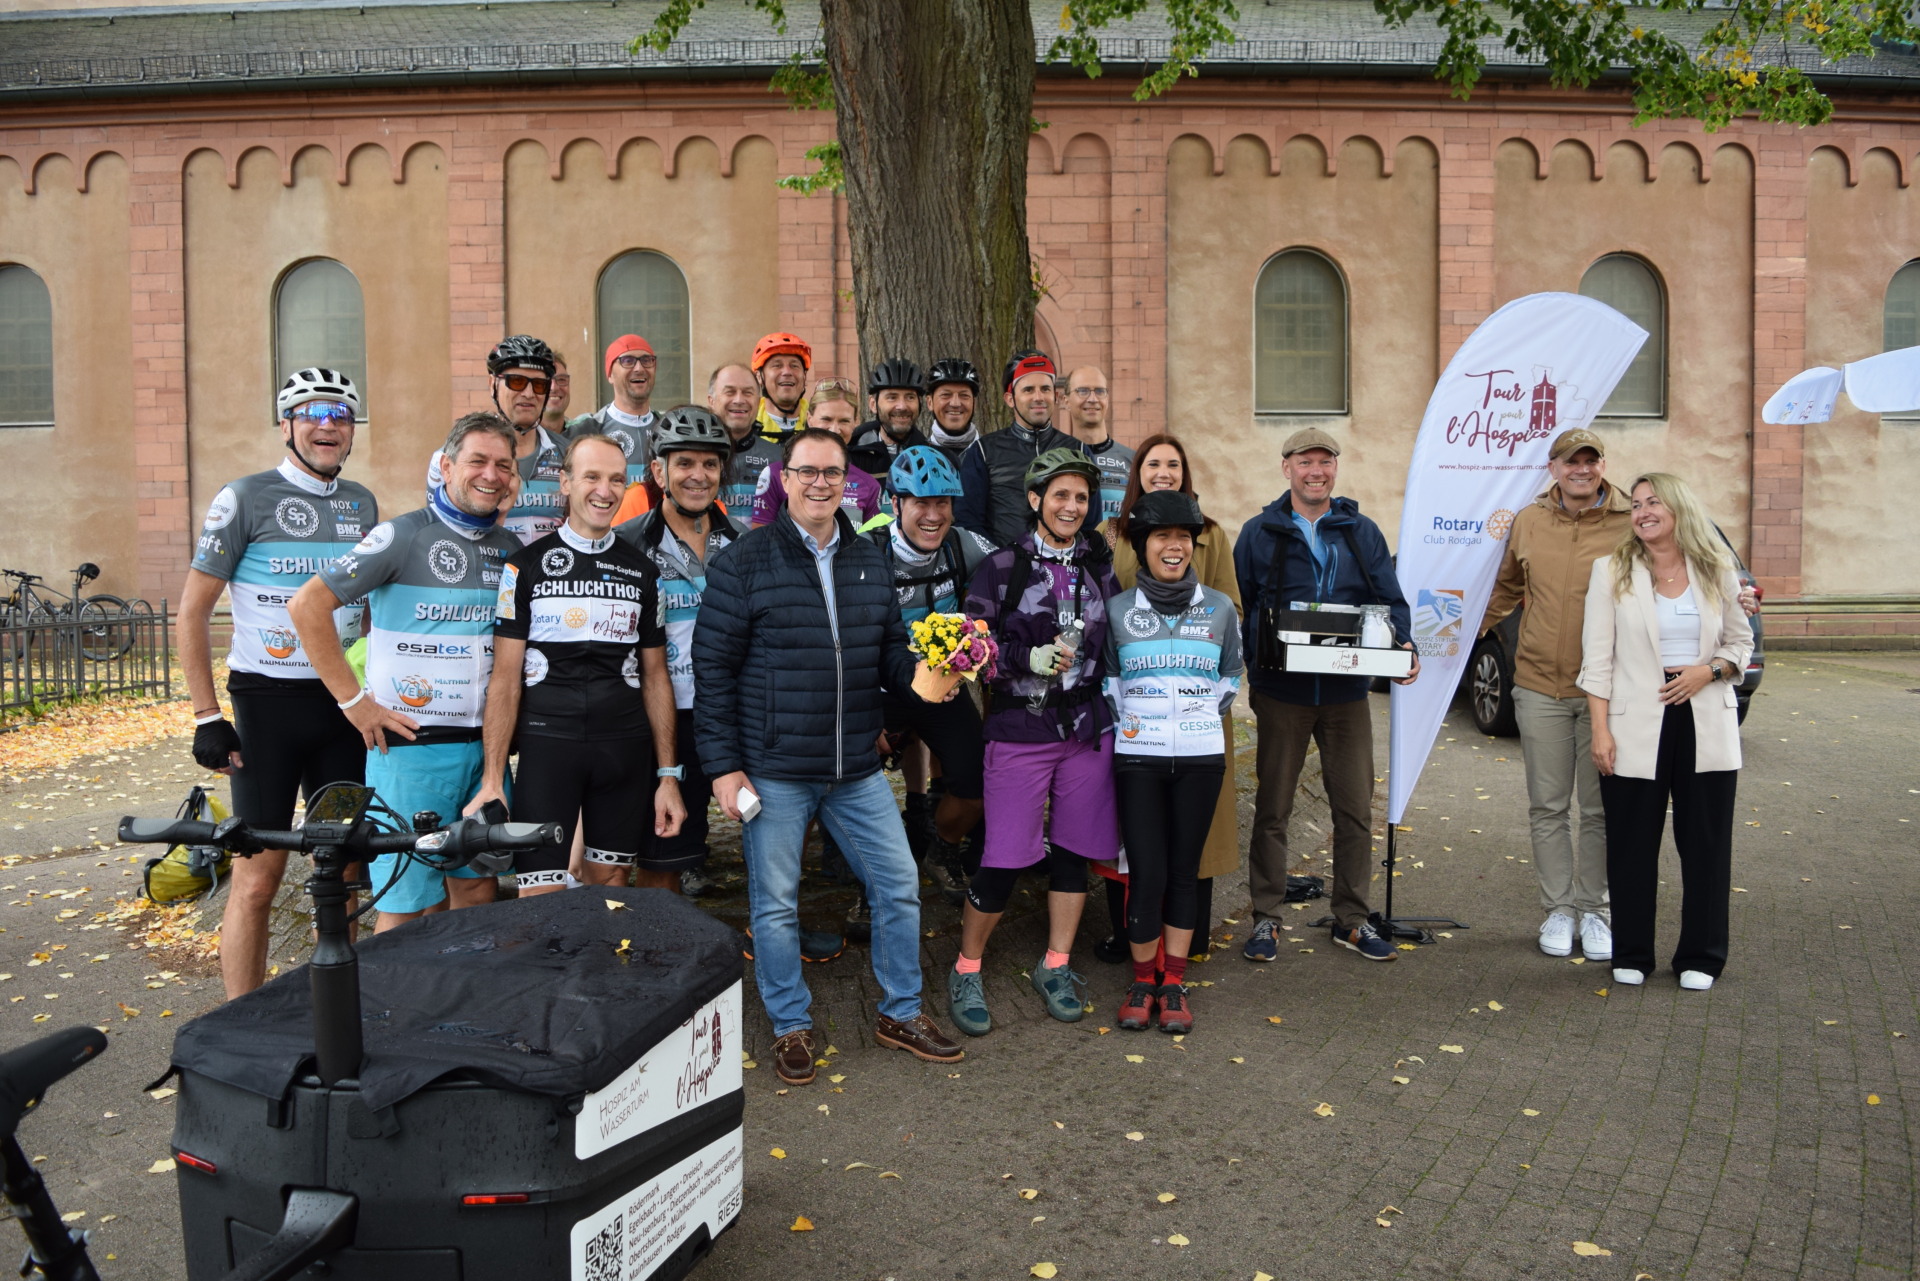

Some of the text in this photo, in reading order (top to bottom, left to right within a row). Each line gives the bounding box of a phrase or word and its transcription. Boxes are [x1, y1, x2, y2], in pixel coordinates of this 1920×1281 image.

[1465, 370, 1525, 409] Tour
[1499, 409, 1525, 427] pour
[1447, 410, 1550, 457] l'Hospice
[745, 455, 769, 465] GSM
[1096, 456, 1126, 470] GSM
[330, 500, 351, 510] NOX
[287, 506, 307, 526] SR
[1433, 517, 1483, 533] Rotary
[336, 523, 362, 535] BMZ
[1424, 535, 1482, 547] Club Rodgau
[440, 550, 457, 571] SR
[479, 545, 500, 558] NOX
[550, 555, 565, 567] SR
[596, 560, 642, 579] Team-Captain
[532, 580, 643, 601] SCHLUCHTHOF
[601, 603, 628, 619] Tour
[1187, 606, 1205, 614] OX
[1133, 614, 1150, 628] SR
[1180, 625, 1210, 635] BMZ
[397, 642, 471, 655] esatek
[1124, 653, 1217, 673] SCHLUCHTHOF
[1178, 685, 1211, 695] KNIPP
[600, 1076, 641, 1121] HOSPIZ AM
[600, 1089, 650, 1140] WASSERTURM
[628, 1158, 704, 1234] Egelsbach Langen Dreieich
[628, 1145, 736, 1250] Neu-Isenburg Dietzenbach Heusenstamm
[628, 1182, 660, 1218] Rödermark
[717, 1192, 740, 1226] RIESE
[628, 1226, 668, 1267] Obertshausen
[670, 1198, 697, 1227] Mühlheim
[699, 1172, 722, 1200] Hainburg
[628, 1245, 664, 1281] Mainhausen
[666, 1222, 687, 1247] Rodgau
